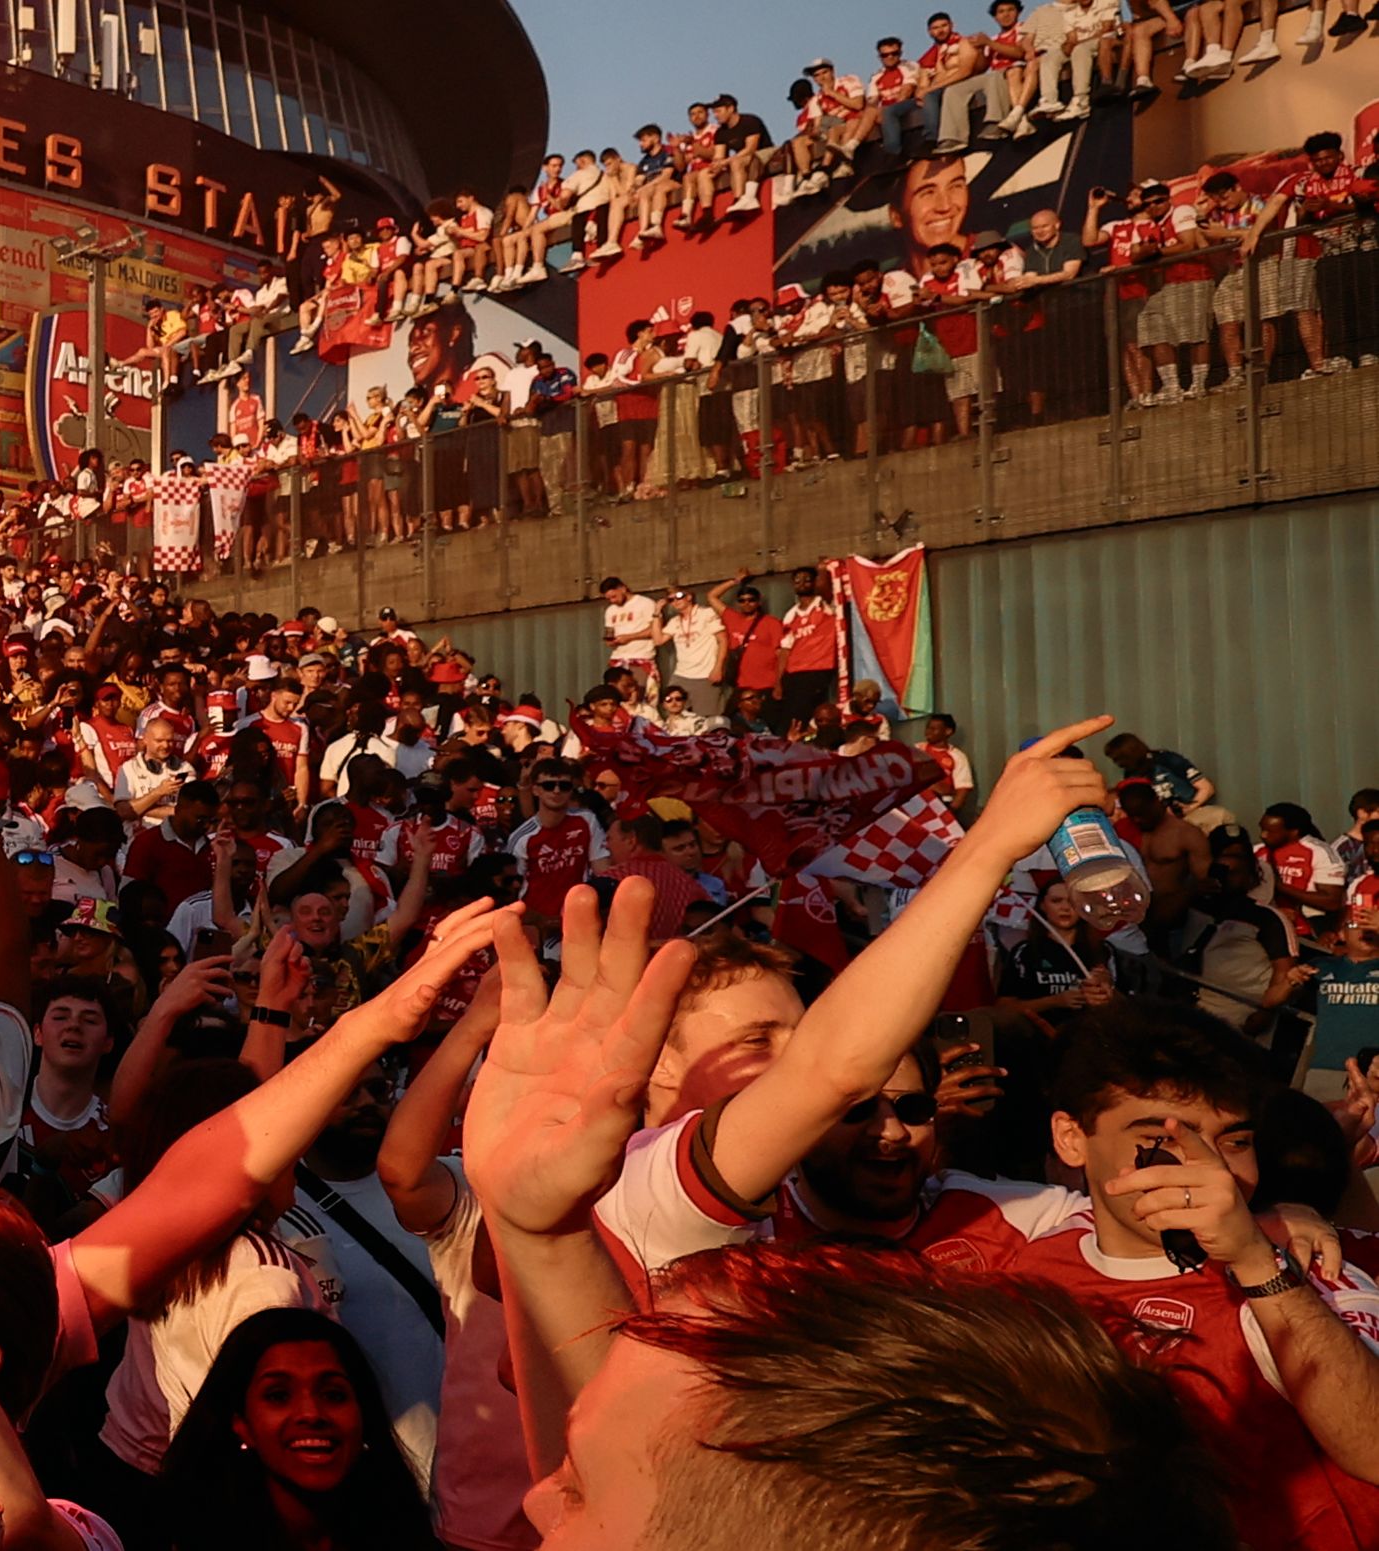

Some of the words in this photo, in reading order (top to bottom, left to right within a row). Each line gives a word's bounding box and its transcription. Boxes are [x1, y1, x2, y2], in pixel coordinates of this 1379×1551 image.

[118, 262, 178, 294] MALDIVES
[1319, 981, 1379, 996] Emirate
[1142, 1303, 1187, 1322] Arsenal
